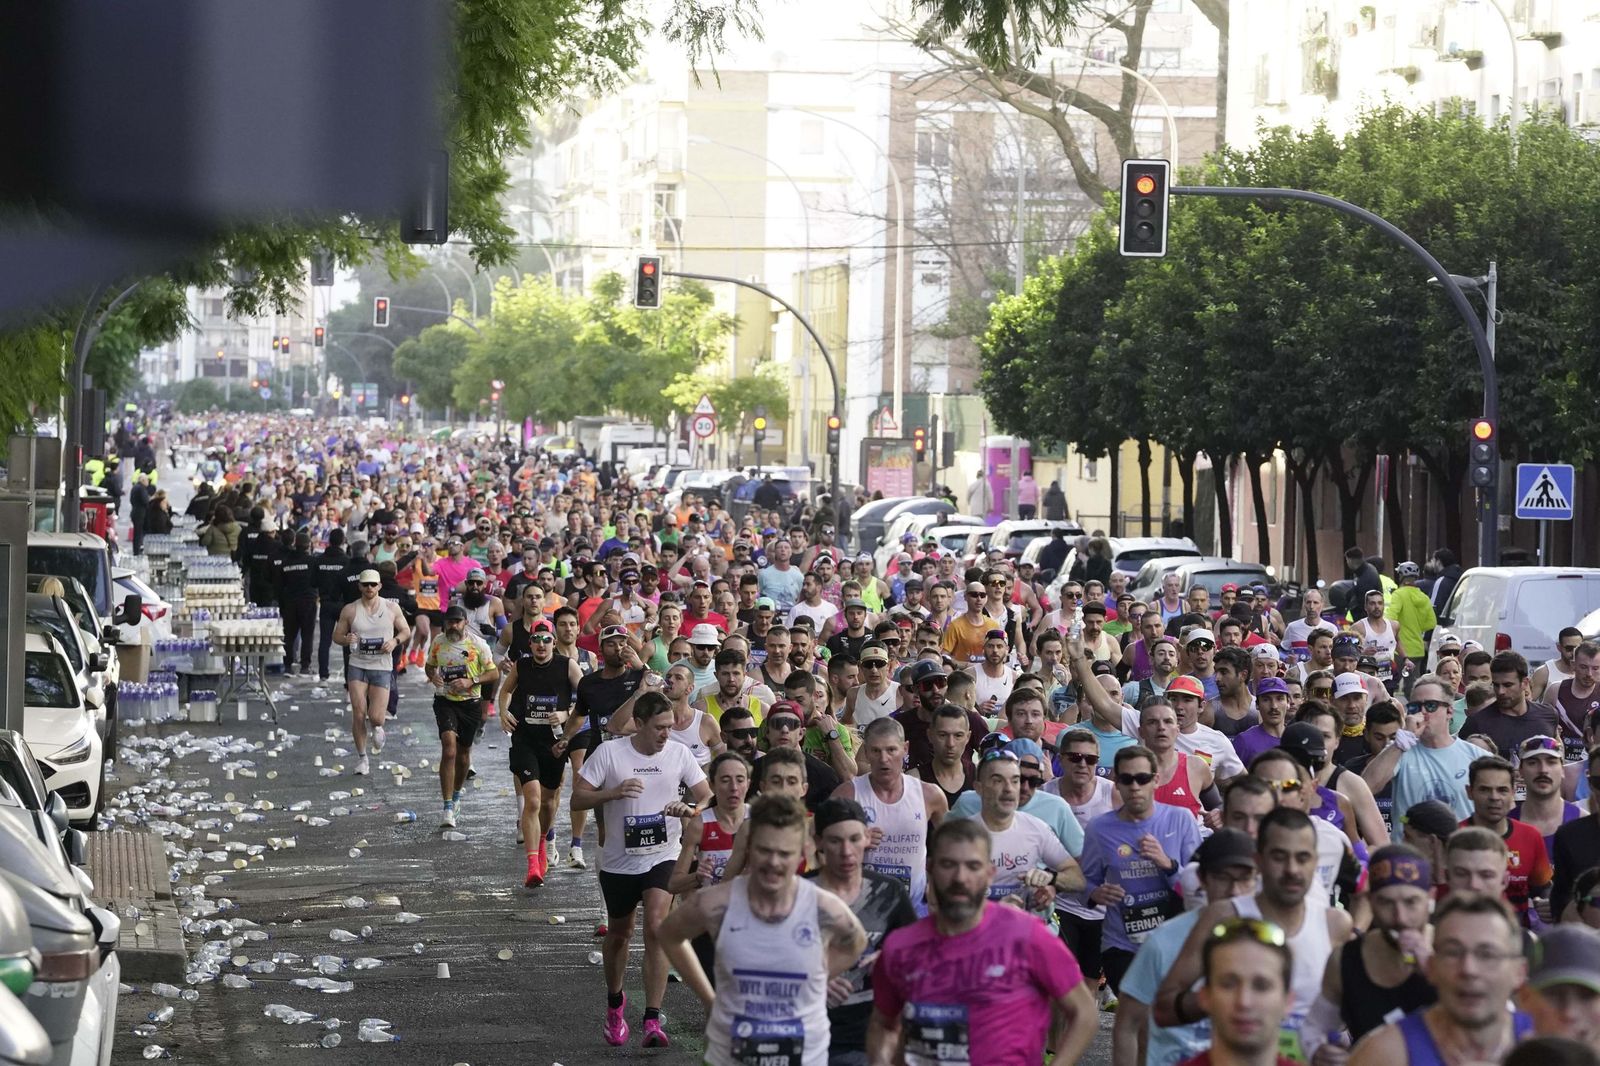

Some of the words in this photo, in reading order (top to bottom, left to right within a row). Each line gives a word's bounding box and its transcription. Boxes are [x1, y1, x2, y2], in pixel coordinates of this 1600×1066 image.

[698, 422, 711, 430] 30
[283, 564, 308, 572] VOLUNTEER
[640, 836, 655, 846] ALE
[881, 833, 920, 843] CALIFATO
[877, 867, 906, 875] ZURICH
[1138, 890, 1169, 902] ZURICH
[756, 1024, 797, 1034] ZURICH
